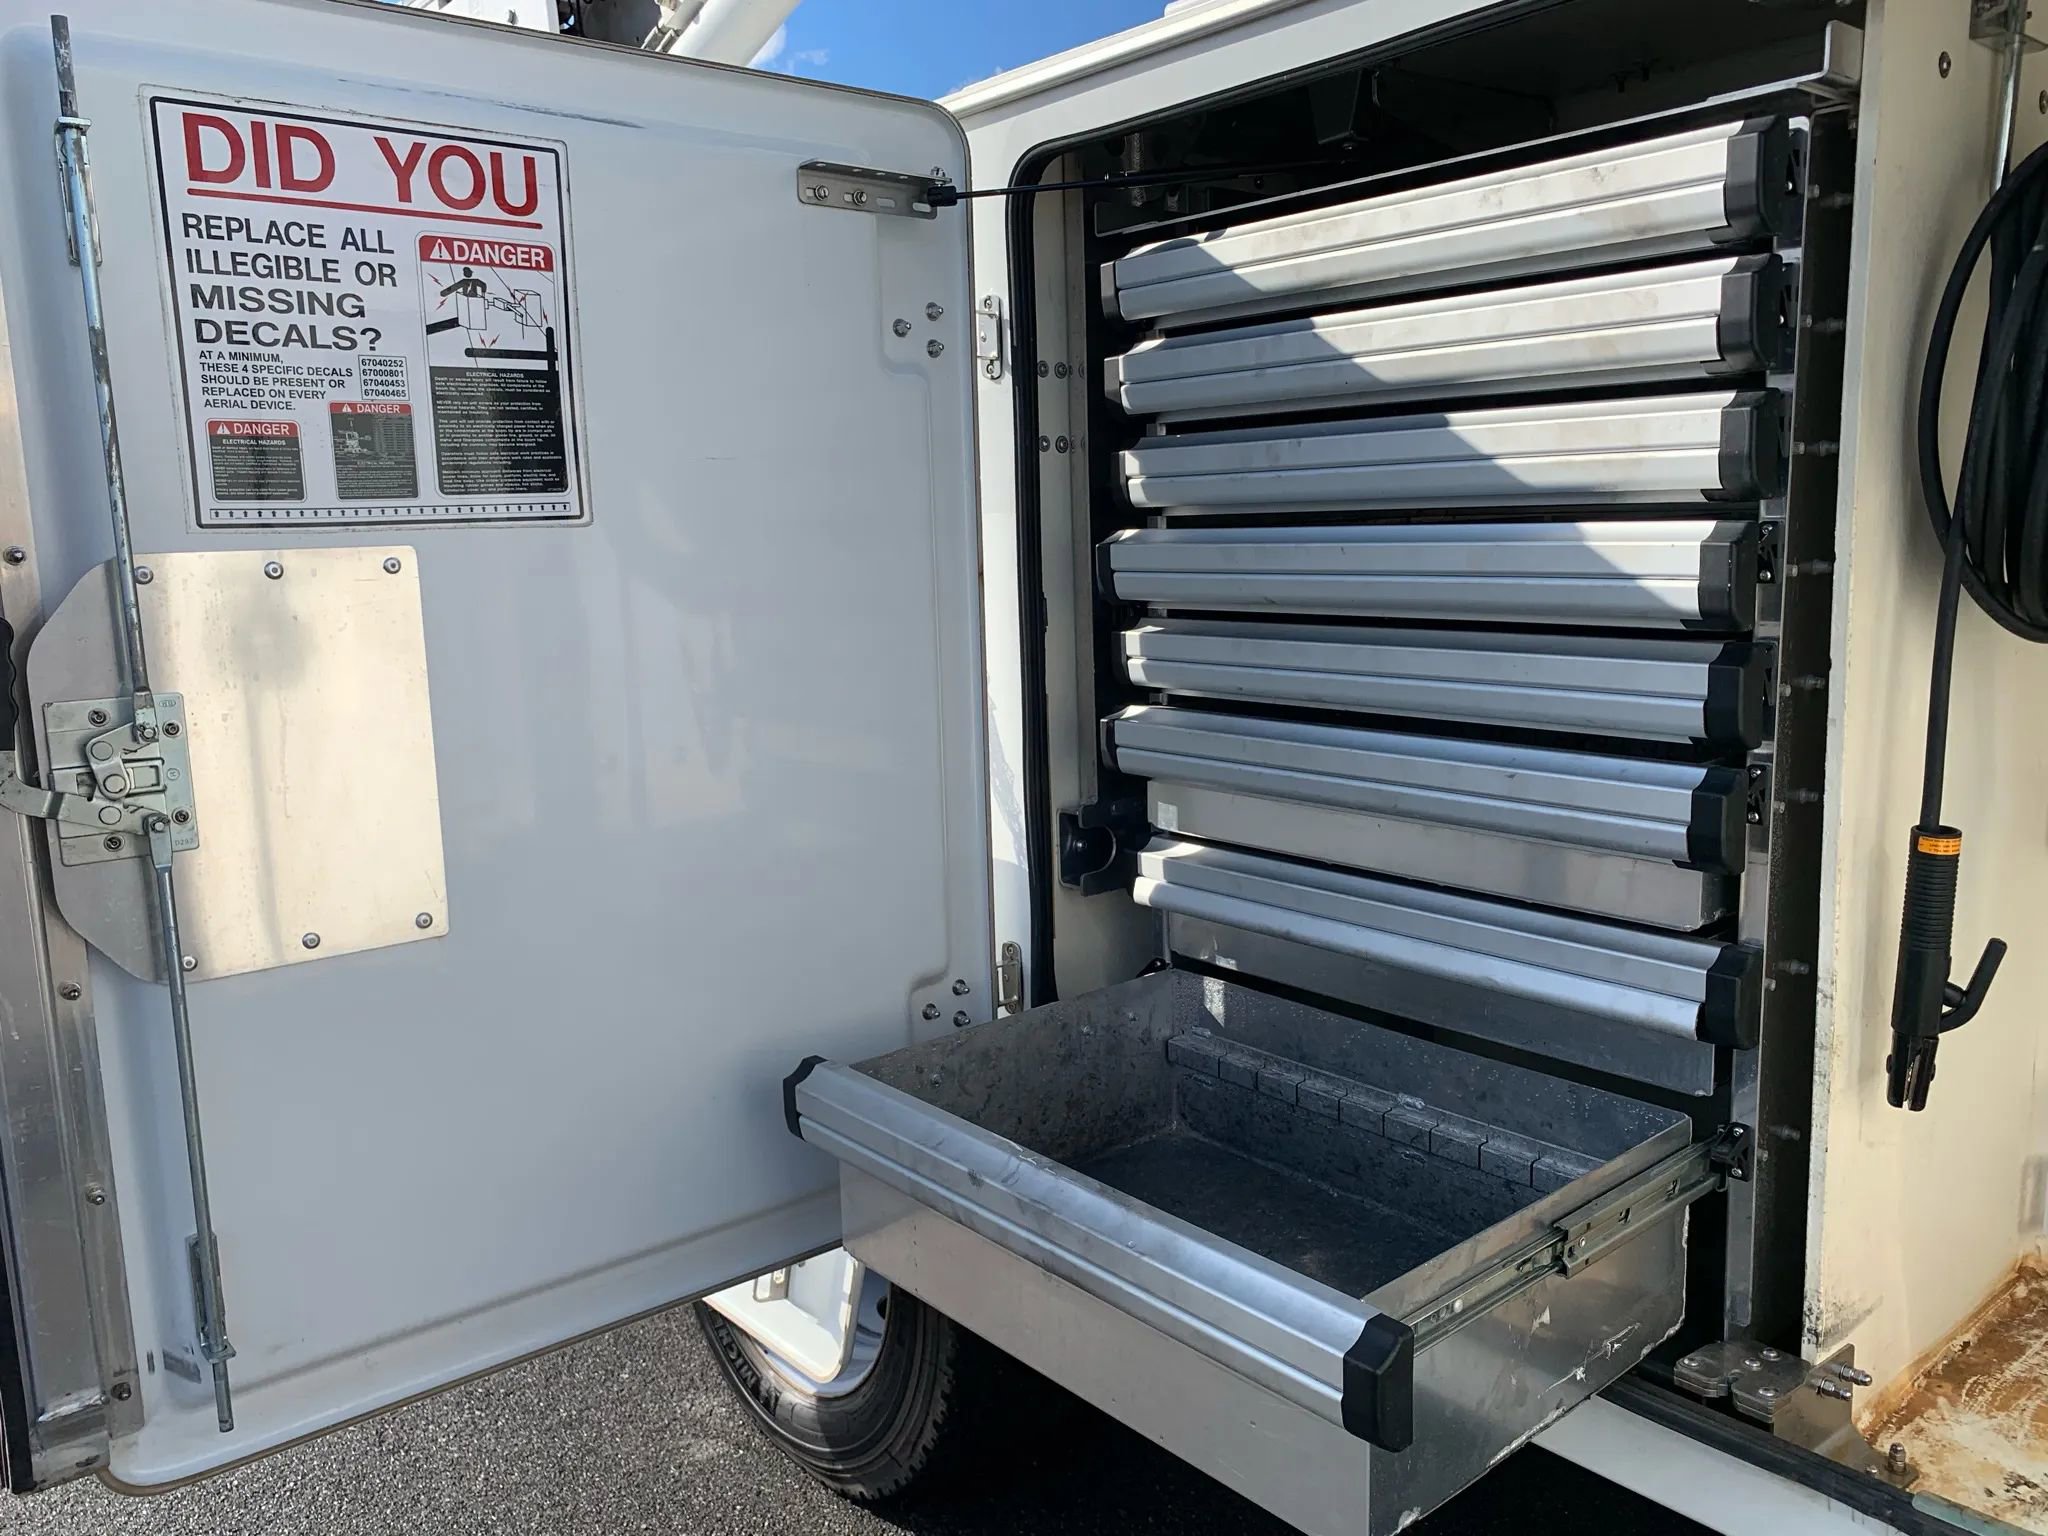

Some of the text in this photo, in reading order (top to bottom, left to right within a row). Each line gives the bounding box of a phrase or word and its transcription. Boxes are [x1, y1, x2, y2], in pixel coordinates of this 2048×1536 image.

[182, 112, 538, 217] DID YOU
[182, 213, 395, 254] REPLACE ALL
[453, 241, 545, 268] DANGER
[186, 249, 398, 287] ILLEGIBLE OR
[190, 284, 366, 318] MISSING
[195, 319, 382, 351] DECALS?
[200, 350, 283, 364] AT A MINIMUM,
[361, 358, 404, 368] 67040252
[200, 362, 353, 377] THESE 4 SPECIFIC DECALS
[362, 368, 404, 378] 67000801
[201, 374, 346, 388] SHOULD BE PRESENT OR
[363, 378, 406, 388] 67040453
[202, 387, 326, 399] REPLACED ON EVERY
[364, 388, 407, 398] 67040465
[204, 399, 296, 411] AERIAL DEVICE.
[357, 404, 400, 413] DANGER
[233, 423, 289, 435] DANGER
